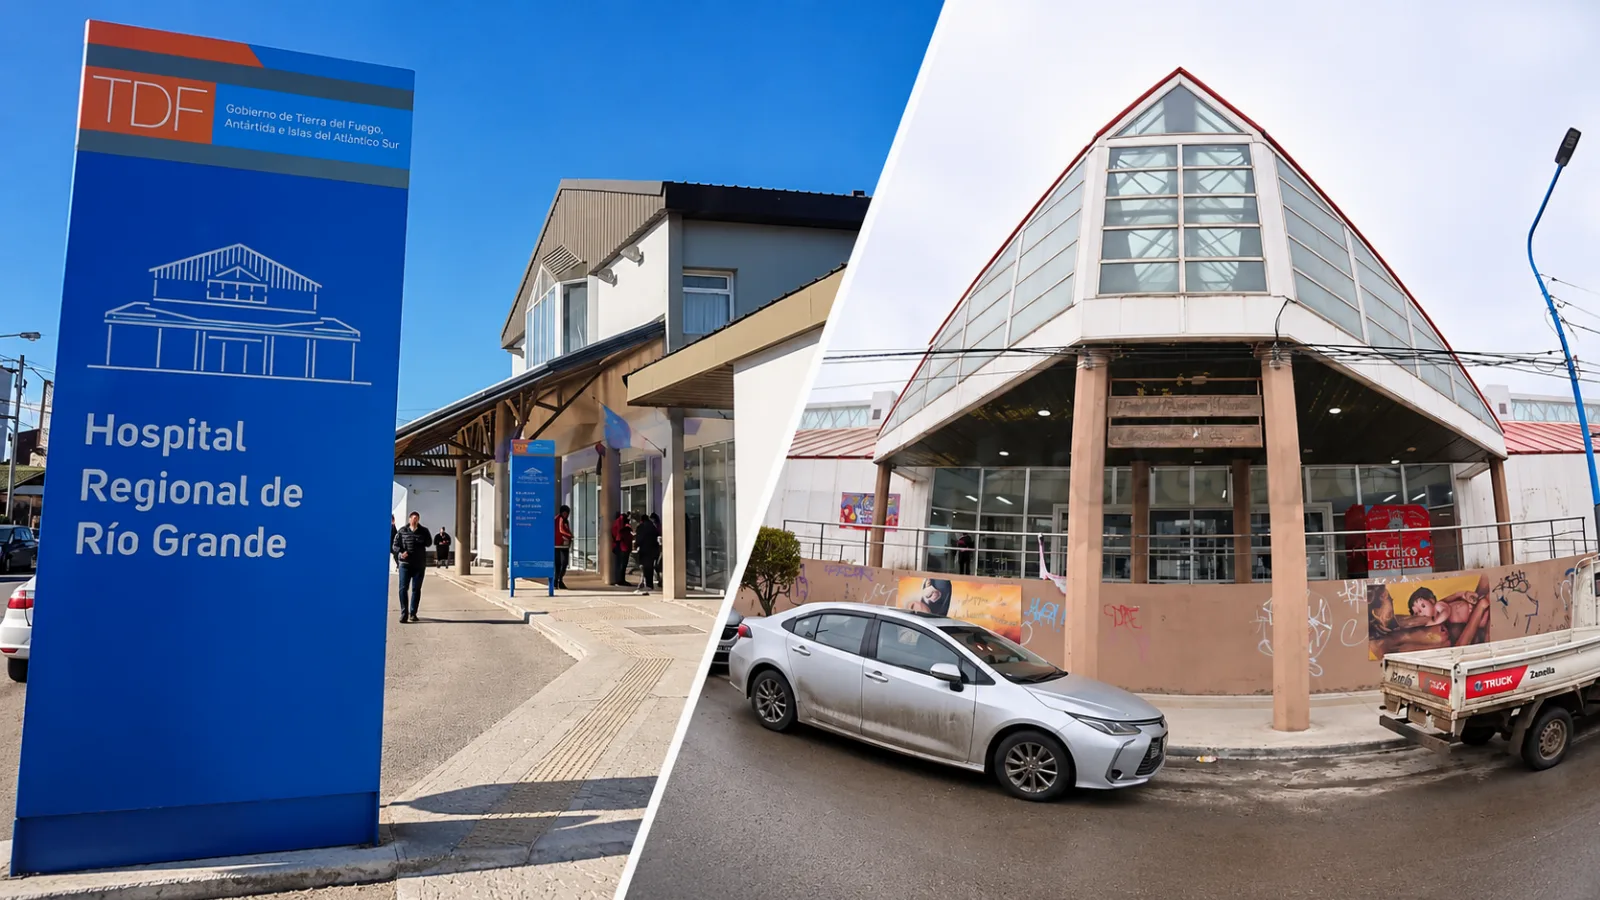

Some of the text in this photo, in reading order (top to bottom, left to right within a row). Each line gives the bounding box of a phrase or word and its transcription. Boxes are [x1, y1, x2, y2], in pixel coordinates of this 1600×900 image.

[93, 75, 208, 131] TDF
[226, 103, 277, 120] Gobierno
[279, 111, 293, 122] de
[296, 113, 327, 127] Tierra
[330, 118, 346, 129] del
[225, 118, 400, 149] Antártida e Islas del Atlántico Sur
[85, 413, 247, 457] Hospital
[80, 468, 304, 512] Regional de
[76, 521, 287, 559] Río Grande
[1485, 676, 1513, 689] TRUCK
